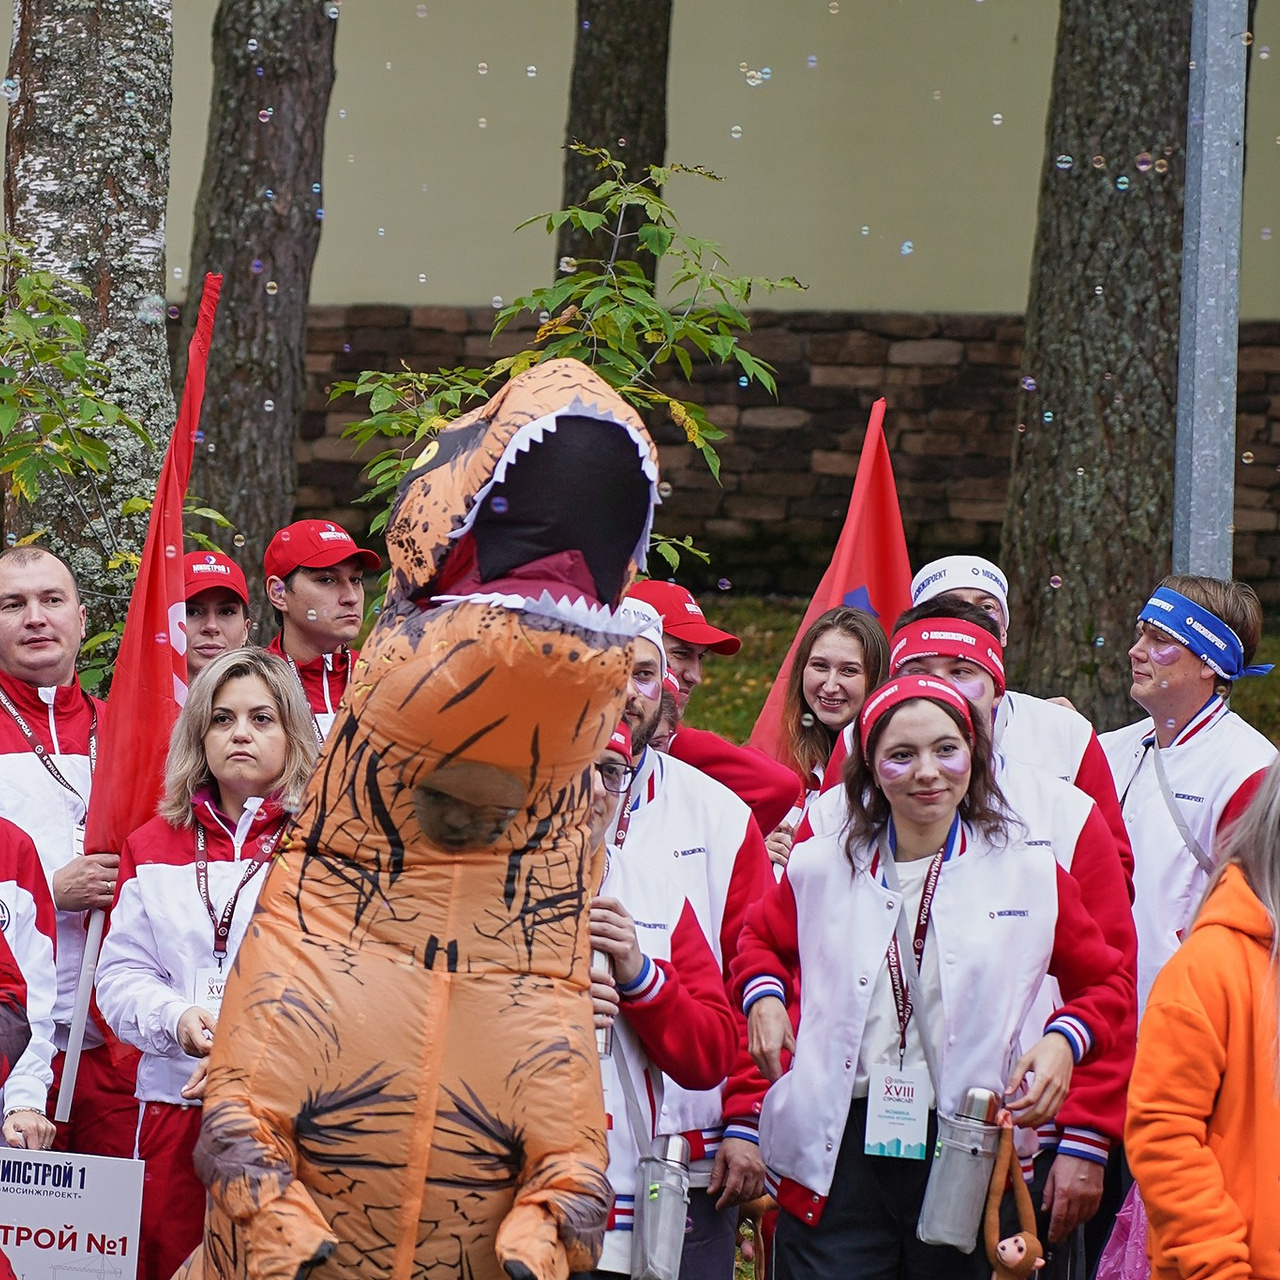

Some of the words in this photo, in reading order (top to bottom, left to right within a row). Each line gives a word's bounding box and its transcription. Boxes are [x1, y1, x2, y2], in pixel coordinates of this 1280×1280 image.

[884, 1084, 914, 1098] XVIII
[78, 1167, 86, 1189] 1
[86, 1233, 128, 1257] №1
